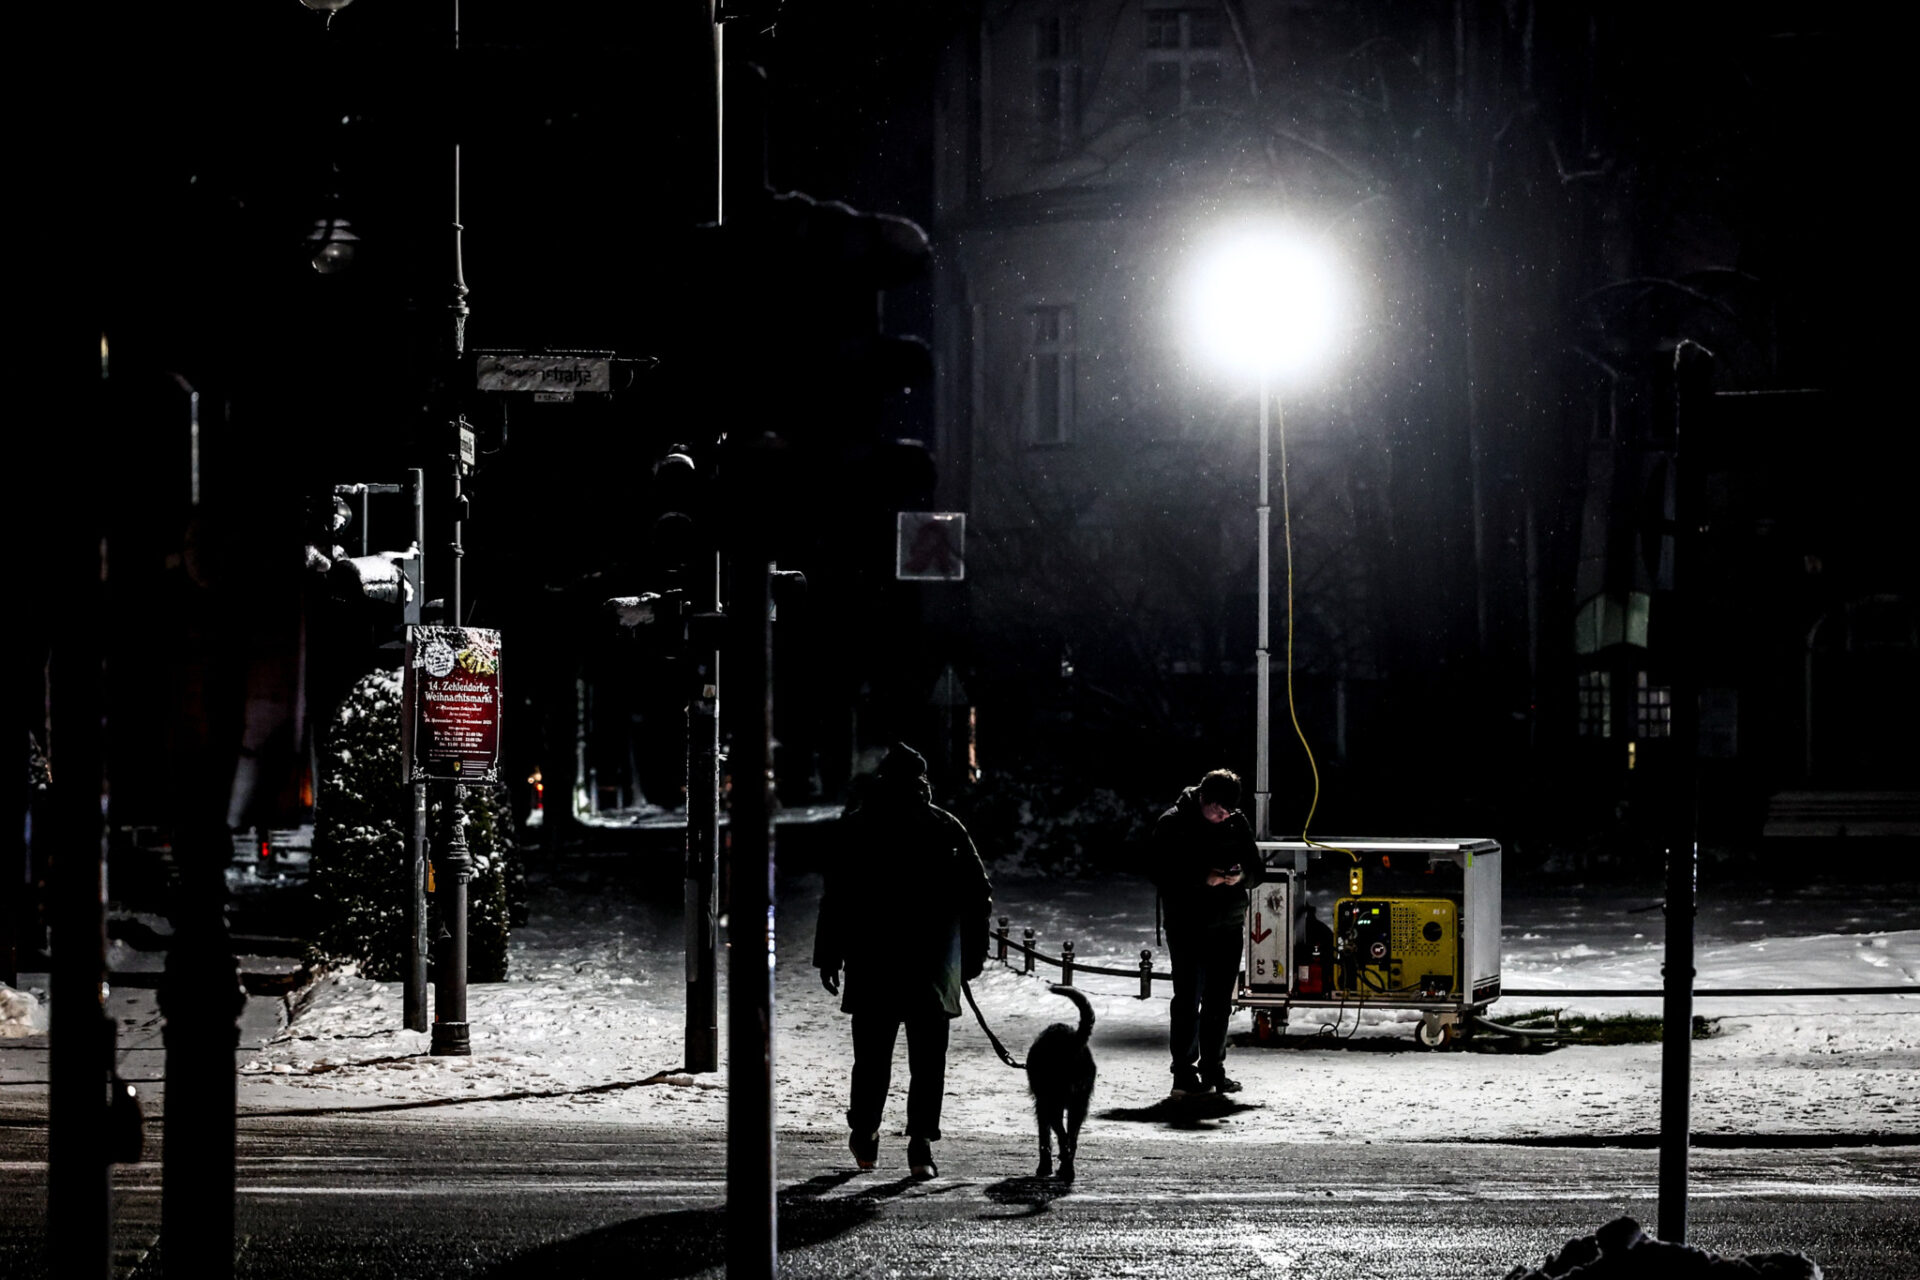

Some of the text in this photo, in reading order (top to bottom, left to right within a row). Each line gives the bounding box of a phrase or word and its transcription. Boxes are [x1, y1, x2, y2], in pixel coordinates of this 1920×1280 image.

[428, 681, 490, 692] 14. Zehlendorfer
[424, 691, 492, 704] Weihnachtsmarkt
[1256, 958, 1265, 975] 2.0
